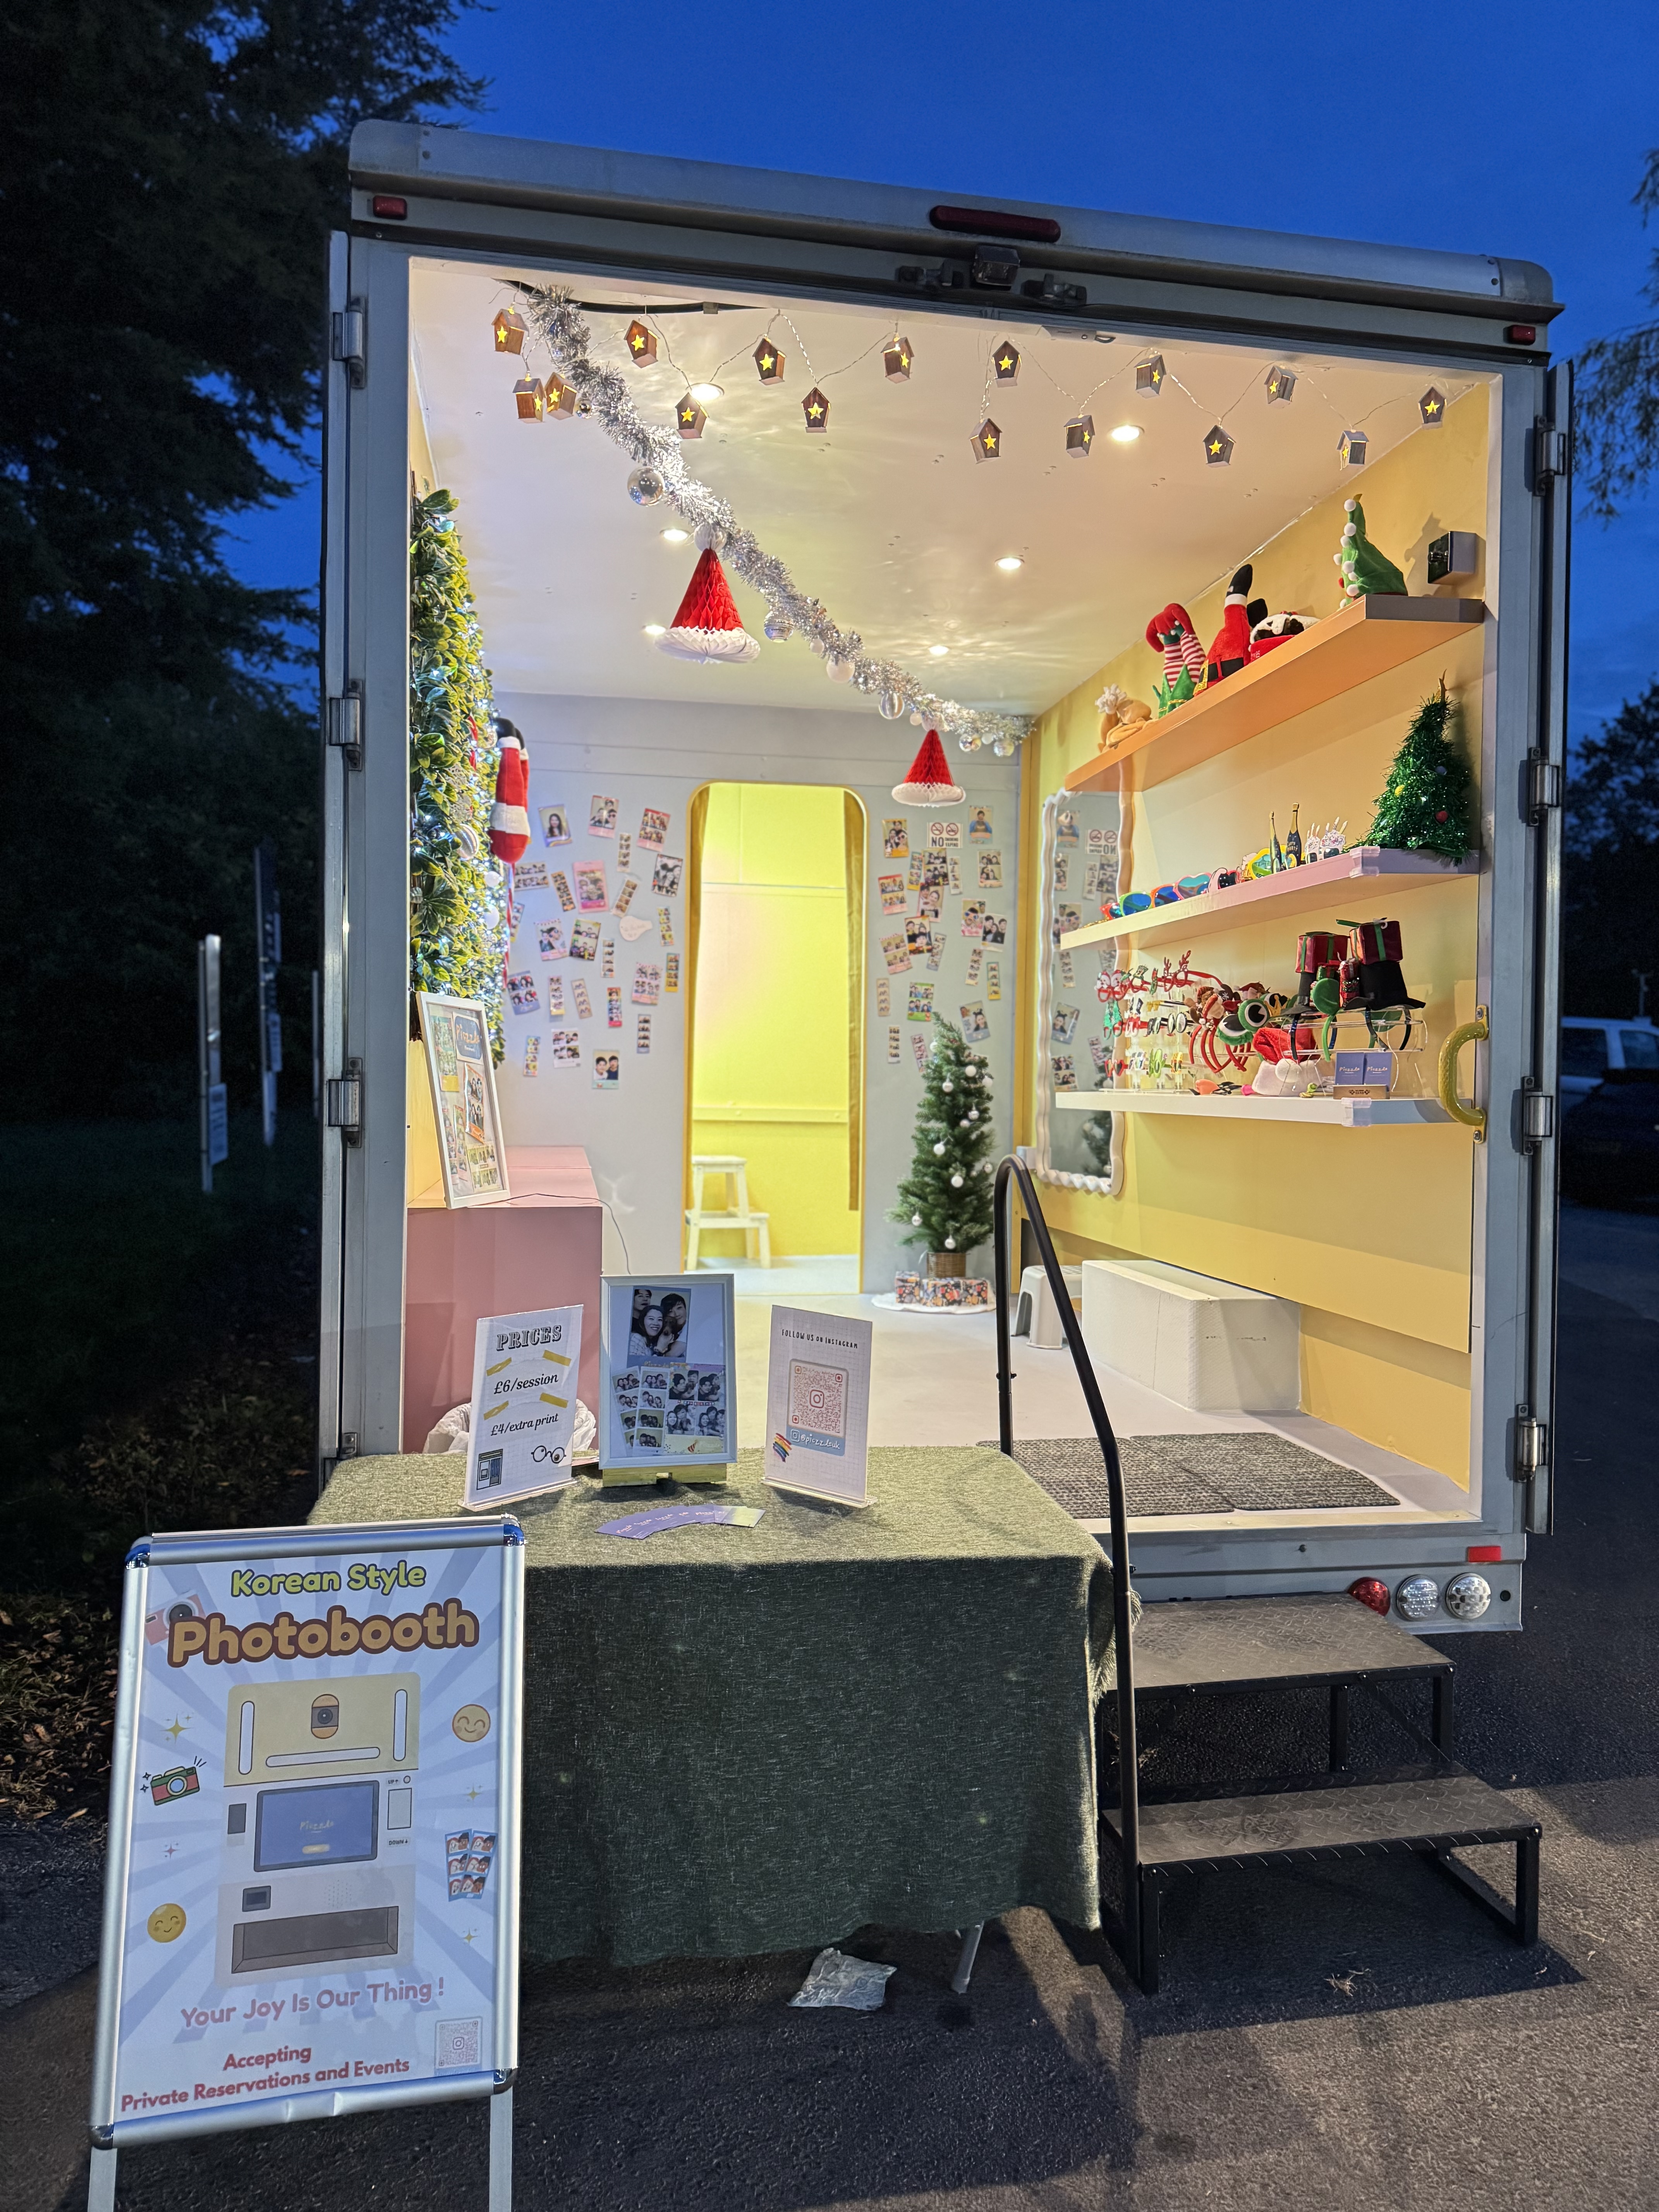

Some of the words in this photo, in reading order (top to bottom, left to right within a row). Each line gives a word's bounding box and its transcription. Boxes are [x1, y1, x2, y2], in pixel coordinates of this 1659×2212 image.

[931, 836, 944, 847] NO
[496, 1325, 562, 1352] PRICES
[782, 1329, 805, 1340] FOLLOW
[494, 1373, 559, 1395] £6/session
[490, 1422, 534, 1436] £4/extra
[534, 1413, 559, 1431] print
[231, 1569, 340, 1597] Korean
[347, 1560, 426, 1595] Style
[167, 1597, 479, 1668] Photobooth
[181, 2005, 237, 2028] Your
[243, 2000, 285, 2021] Joy
[292, 1993, 310, 2013] Is
[316, 1988, 360, 2009] Our
[367, 1981, 432, 2007] Thing
[223, 2045, 312, 2071] Accepting
[121, 2091, 189, 2112] Private
[194, 2071, 310, 2100] Reservations
[315, 2063, 349, 2082] and
[354, 2058, 410, 2078] Events
